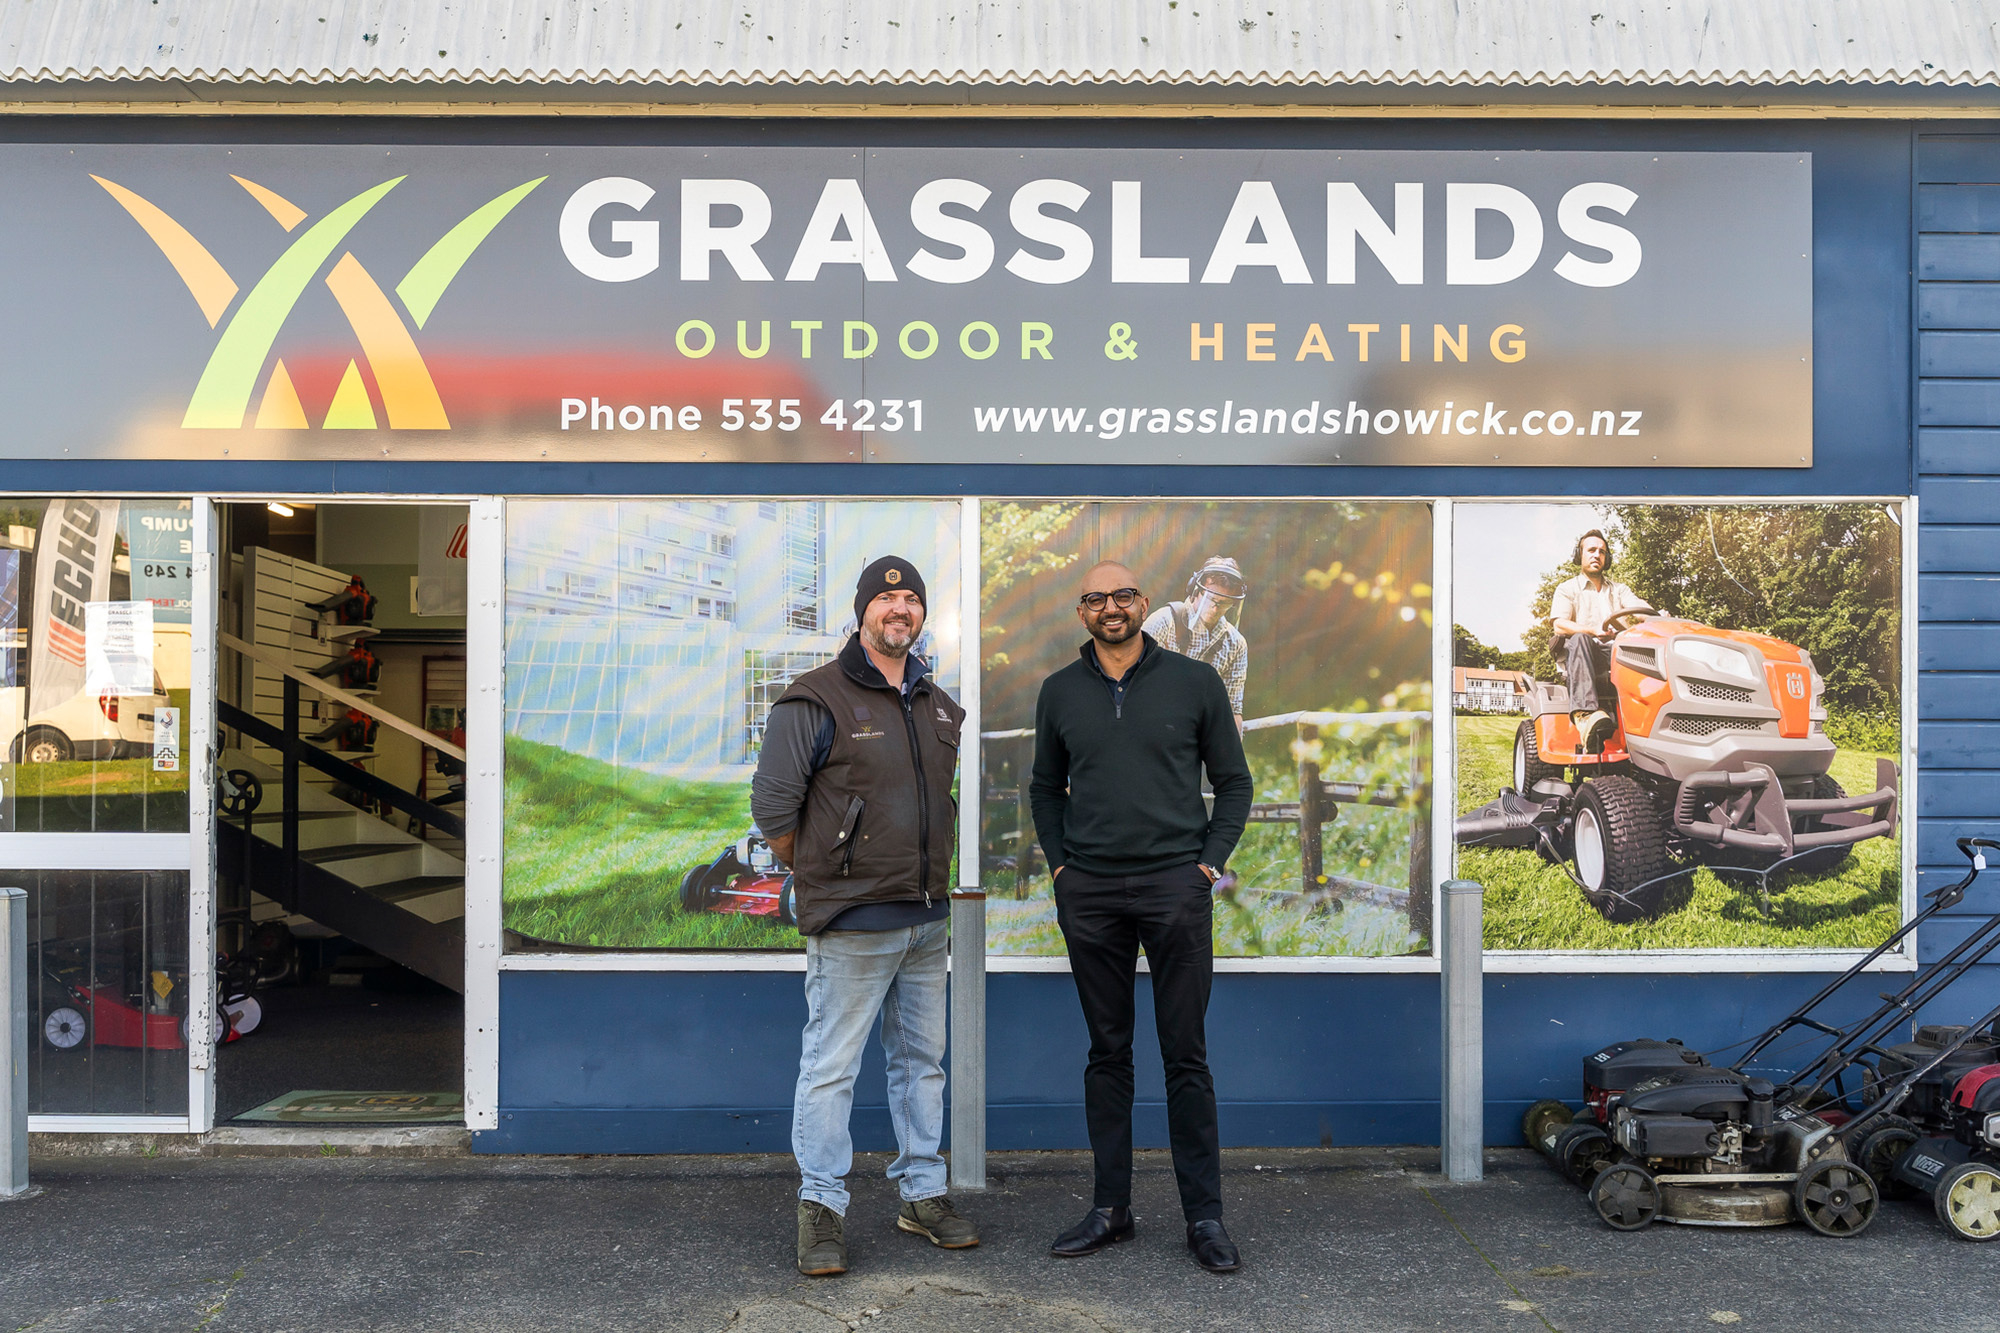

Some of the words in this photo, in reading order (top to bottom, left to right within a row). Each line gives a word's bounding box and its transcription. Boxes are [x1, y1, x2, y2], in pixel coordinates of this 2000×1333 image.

[558, 176, 1643, 288] GRASSLANDS
[674, 319, 1055, 360] OUTDOOR
[1104, 321, 1139, 362] &
[1190, 322, 1528, 364] HEATING
[560, 397, 703, 431] Phone
[720, 398, 802, 432] 535
[820, 398, 924, 433] 4231
[973, 400, 1644, 440] www.grasslandshowick.co.nz
[50, 500, 101, 627] ECHO
